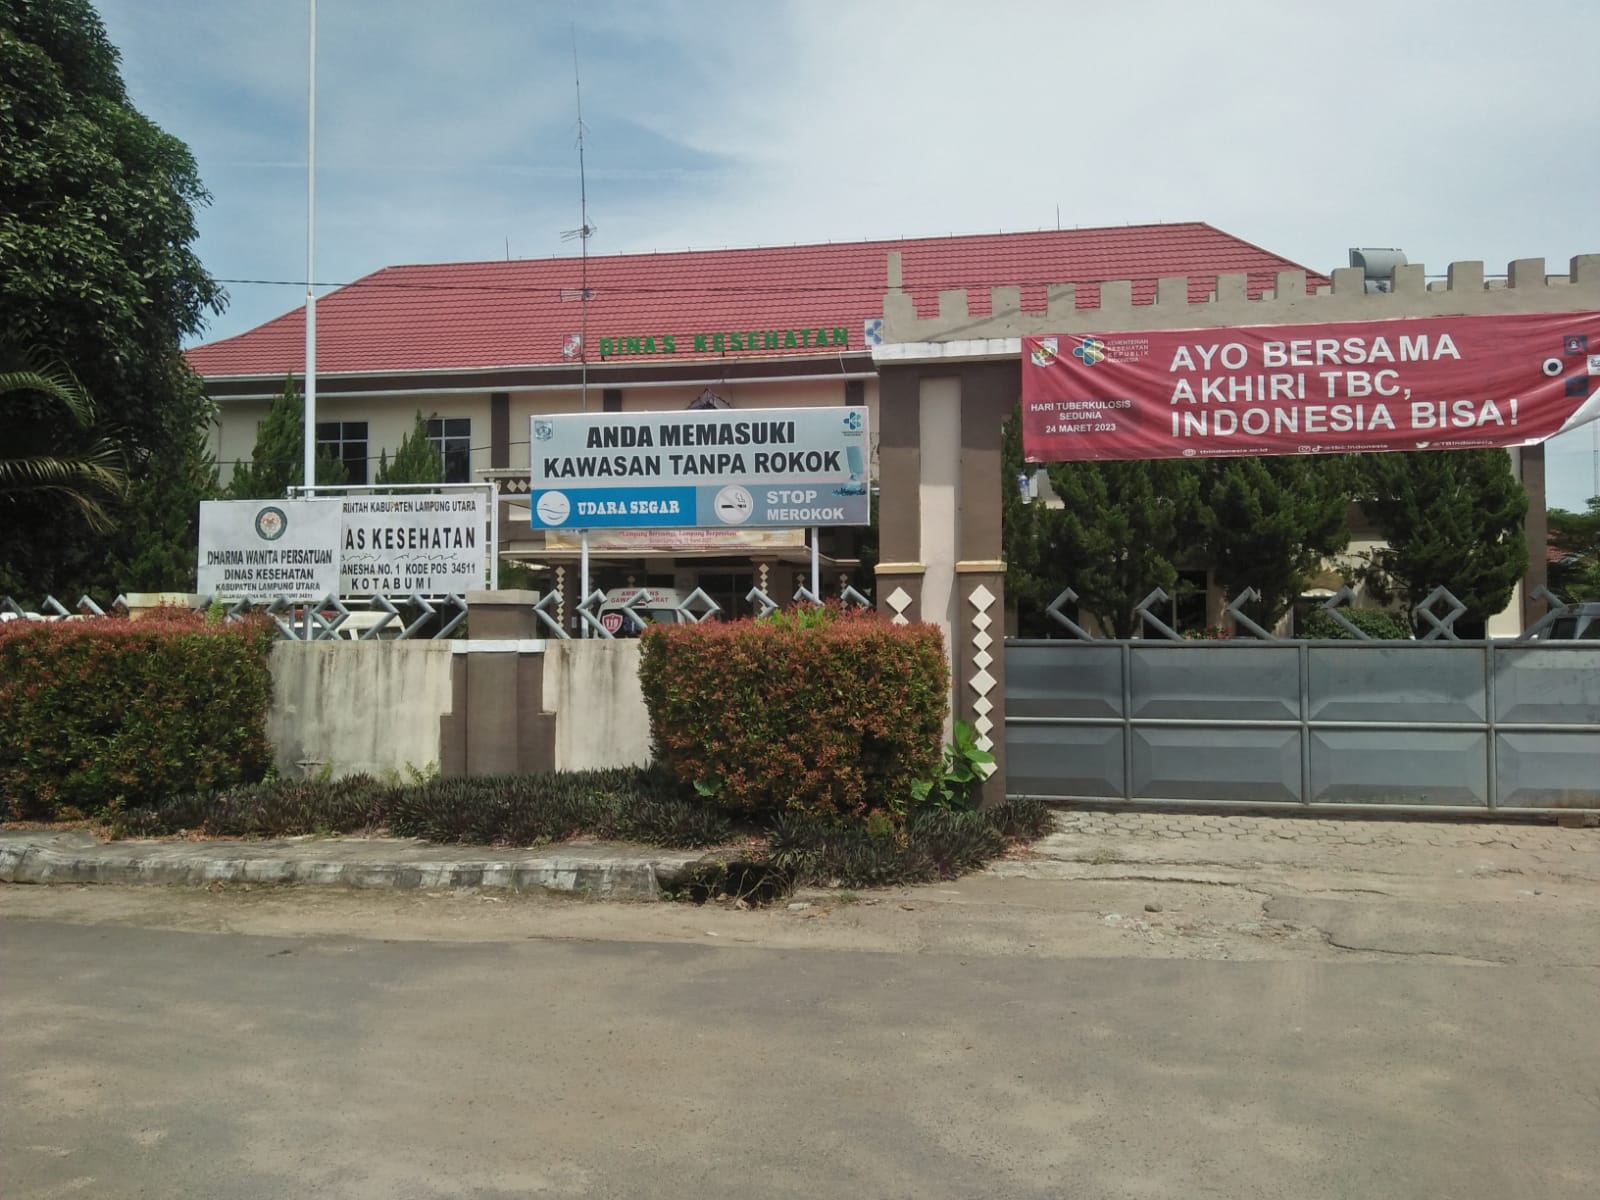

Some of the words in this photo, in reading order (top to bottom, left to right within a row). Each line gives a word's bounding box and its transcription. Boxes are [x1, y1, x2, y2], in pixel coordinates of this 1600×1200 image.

[600, 336, 676, 356] DINAS
[694, 327, 849, 352] KESEHATAN
[1170, 343, 1247, 372] AYO
[1264, 333, 1461, 368] BERSAMA
[1170, 374, 1305, 404] AKHIRI
[1320, 369, 1411, 400] TBC,
[1031, 403, 1054, 412] HARI
[1055, 400, 1131, 411] TUBERKULOSIS
[1059, 411, 1102, 421] SEDUNIA
[1172, 404, 1396, 437] INDONESIA
[1411, 399, 1518, 429] BISA!
[587, 426, 653, 449] ANDA
[660, 421, 796, 447] MEMASUKI
[1045, 425, 1057, 434] 24
[1058, 424, 1092, 433] MARET
[1095, 423, 1116, 432] 2023
[544, 455, 662, 478] KAWASAN
[669, 453, 746, 475] TANPA
[755, 450, 841, 473] ROKOK
[767, 490, 817, 504] STOP
[370, 501, 413, 513] KABUPATEN
[415, 501, 450, 512] LAMPUNG
[453, 500, 477, 512] UTARA
[577, 502, 628, 516] UDARA
[629, 500, 681, 514] SEGAR
[767, 507, 845, 521] MEROKOK
[345, 528, 366, 550] AS
[372, 527, 475, 550] KESEHATAN
[207, 551, 244, 565] DHARMA
[245, 550, 278, 564] WANITA
[281, 549, 332, 564] PERSATUAN
[224, 569, 253, 580] DINAS
[256, 568, 314, 580] KESEHATAN
[341, 564, 375, 576] ANESHA
[378, 564, 393, 575] NO.
[395, 564, 400, 575] 1
[406, 563, 428, 575] KODE
[431, 563, 447, 574] POS
[451, 562, 476, 574] 34511
[215, 583, 257, 592] KABUPATEN
[258, 582, 293, 591] LAMPUNG
[296, 582, 320, 591] UTARA
[351, 577, 431, 590] KOTABUMI
